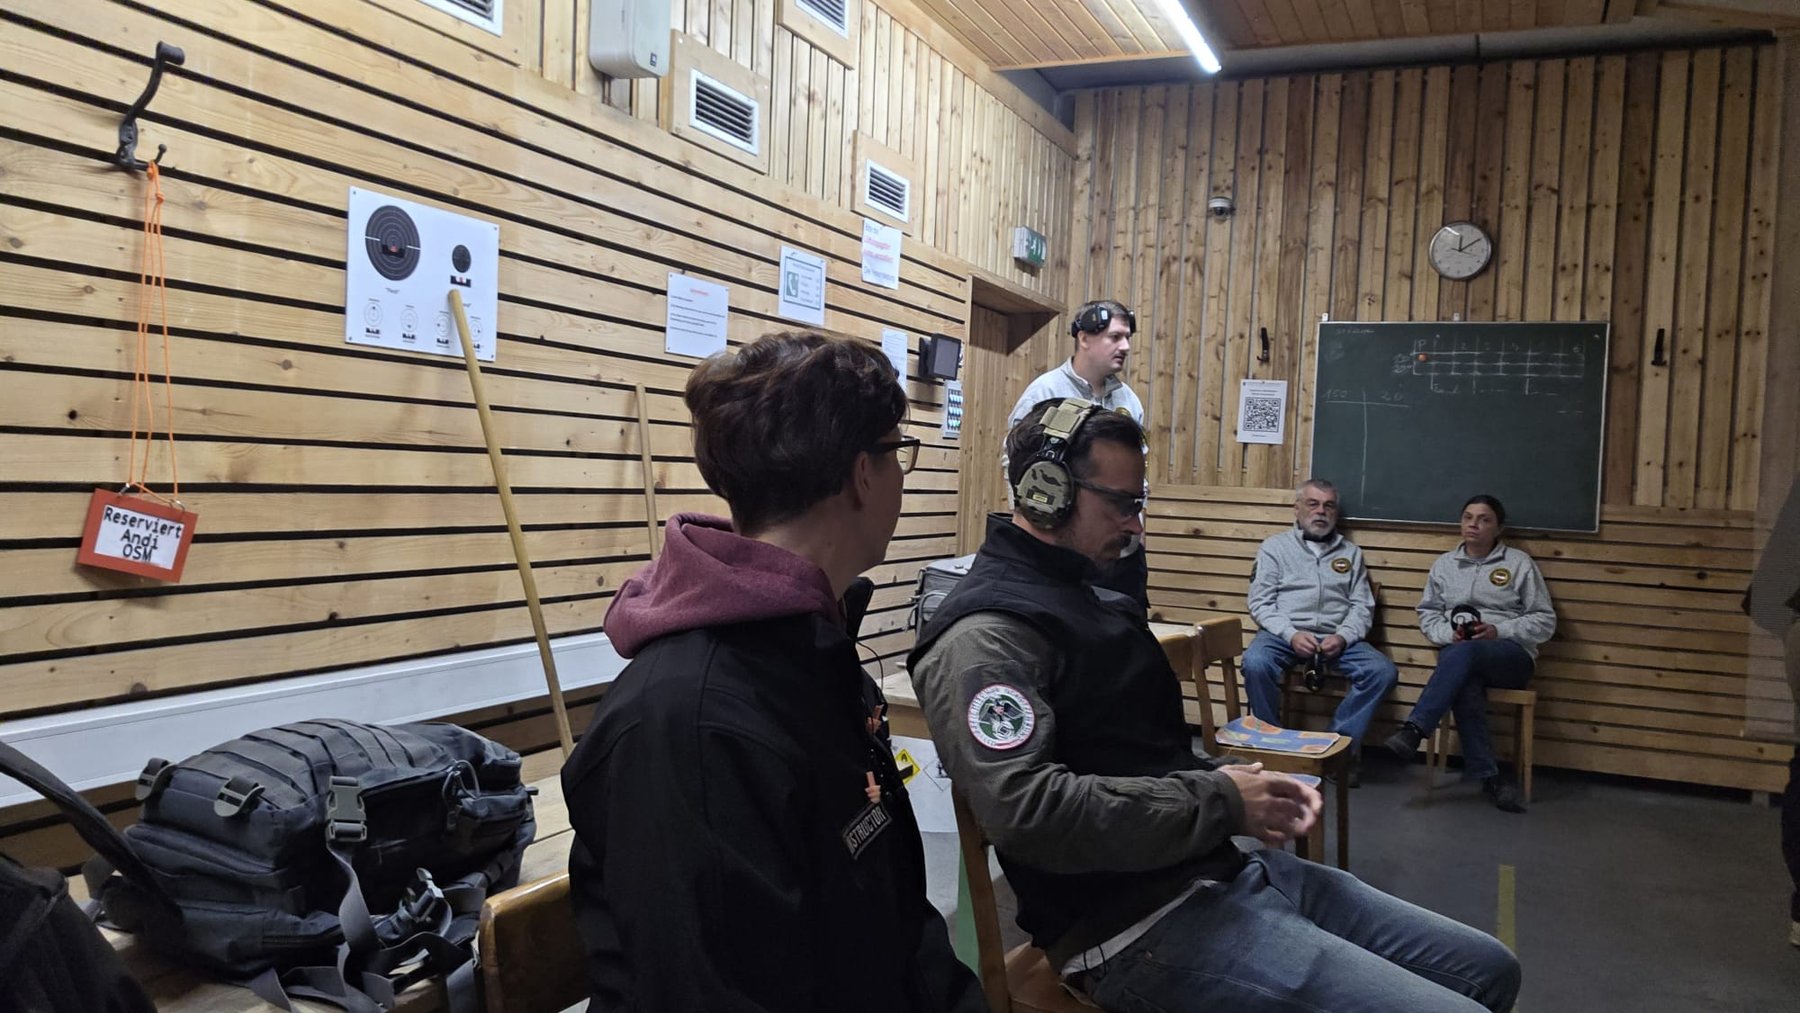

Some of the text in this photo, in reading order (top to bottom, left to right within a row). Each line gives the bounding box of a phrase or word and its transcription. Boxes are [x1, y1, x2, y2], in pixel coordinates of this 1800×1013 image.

[104, 507, 182, 539] Reserviert
[121, 528, 159, 549] Andi
[122, 544, 153, 562] OSM
[846, 806, 886, 855] NSTRUCTOR
